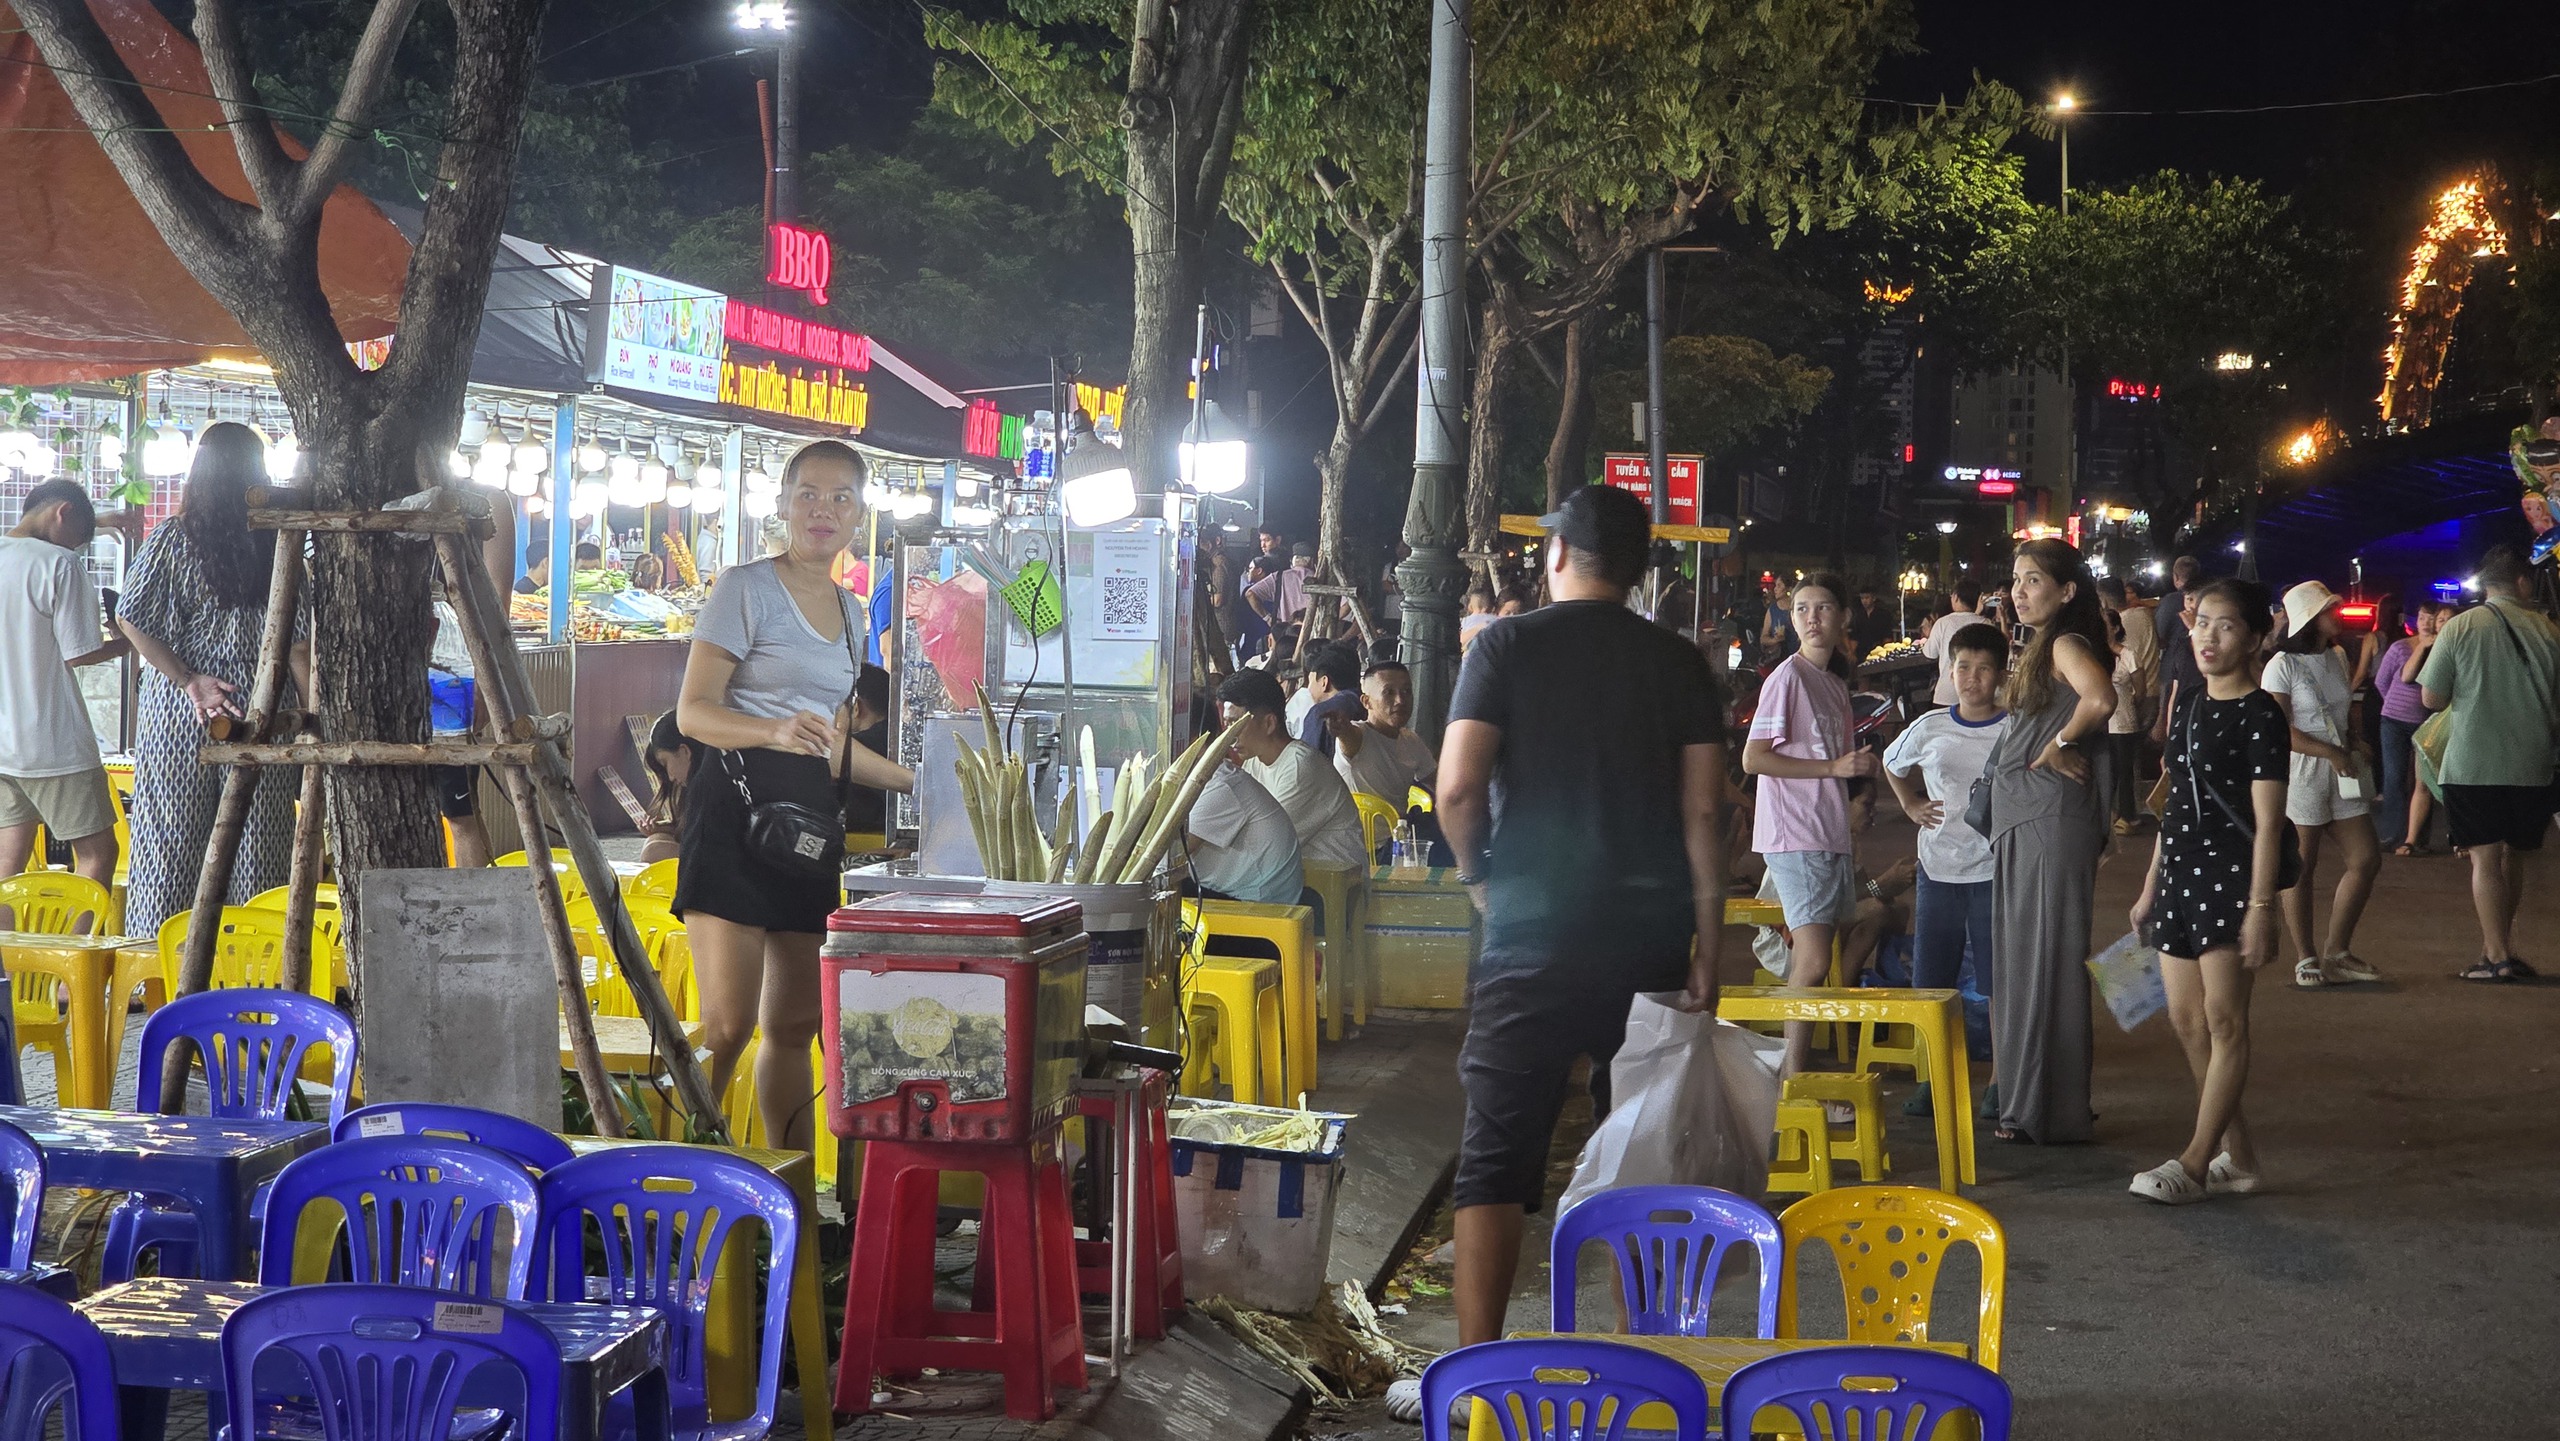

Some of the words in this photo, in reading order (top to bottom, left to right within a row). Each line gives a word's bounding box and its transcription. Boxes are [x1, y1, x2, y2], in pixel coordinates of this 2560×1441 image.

[777, 226, 829, 306] BBQ
[751, 308, 781, 349] GRILLED
[782, 317, 802, 352] MEAT
[805, 324, 839, 363] NOODLES
[842, 333, 870, 372] SNACKS
